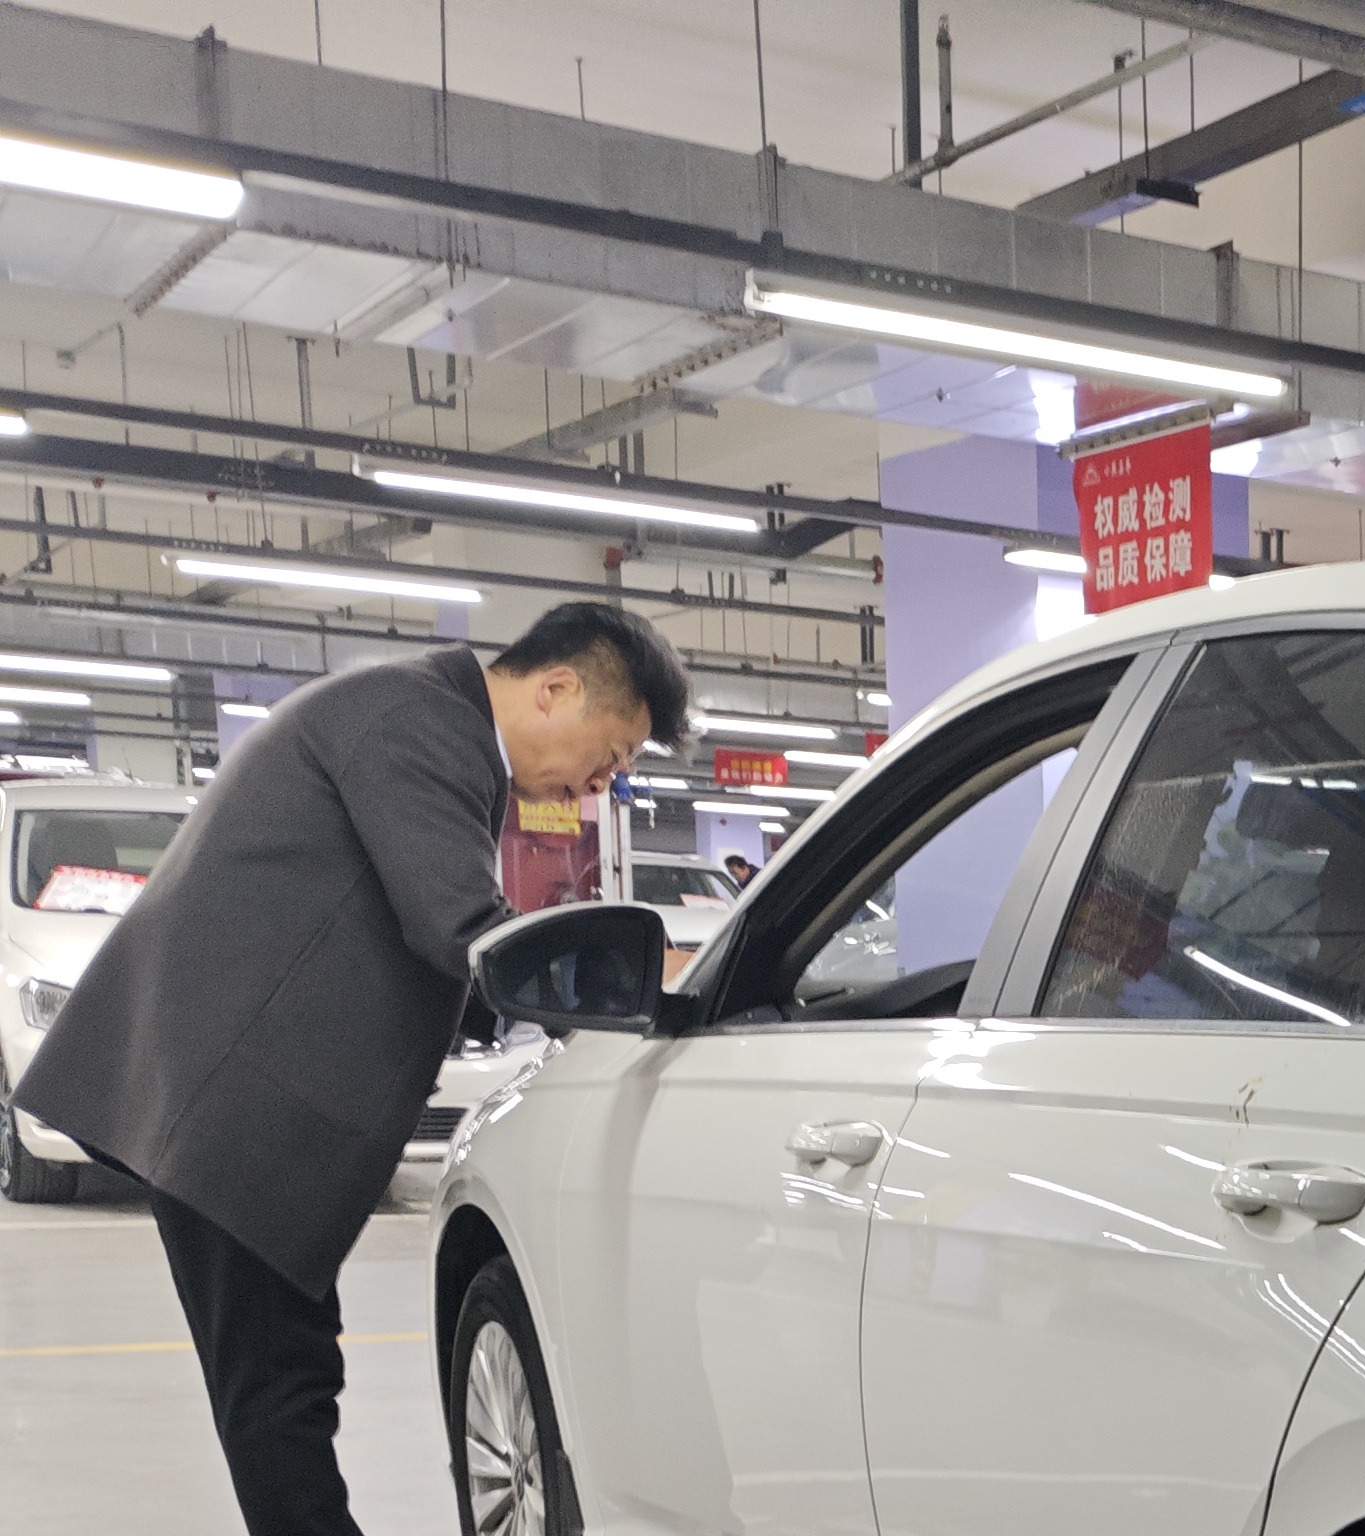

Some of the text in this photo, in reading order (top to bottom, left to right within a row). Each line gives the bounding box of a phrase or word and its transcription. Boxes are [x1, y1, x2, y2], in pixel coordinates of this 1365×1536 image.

[1094, 475, 1191, 539] 权威检测
[1096, 529, 1192, 591] 品质保障
